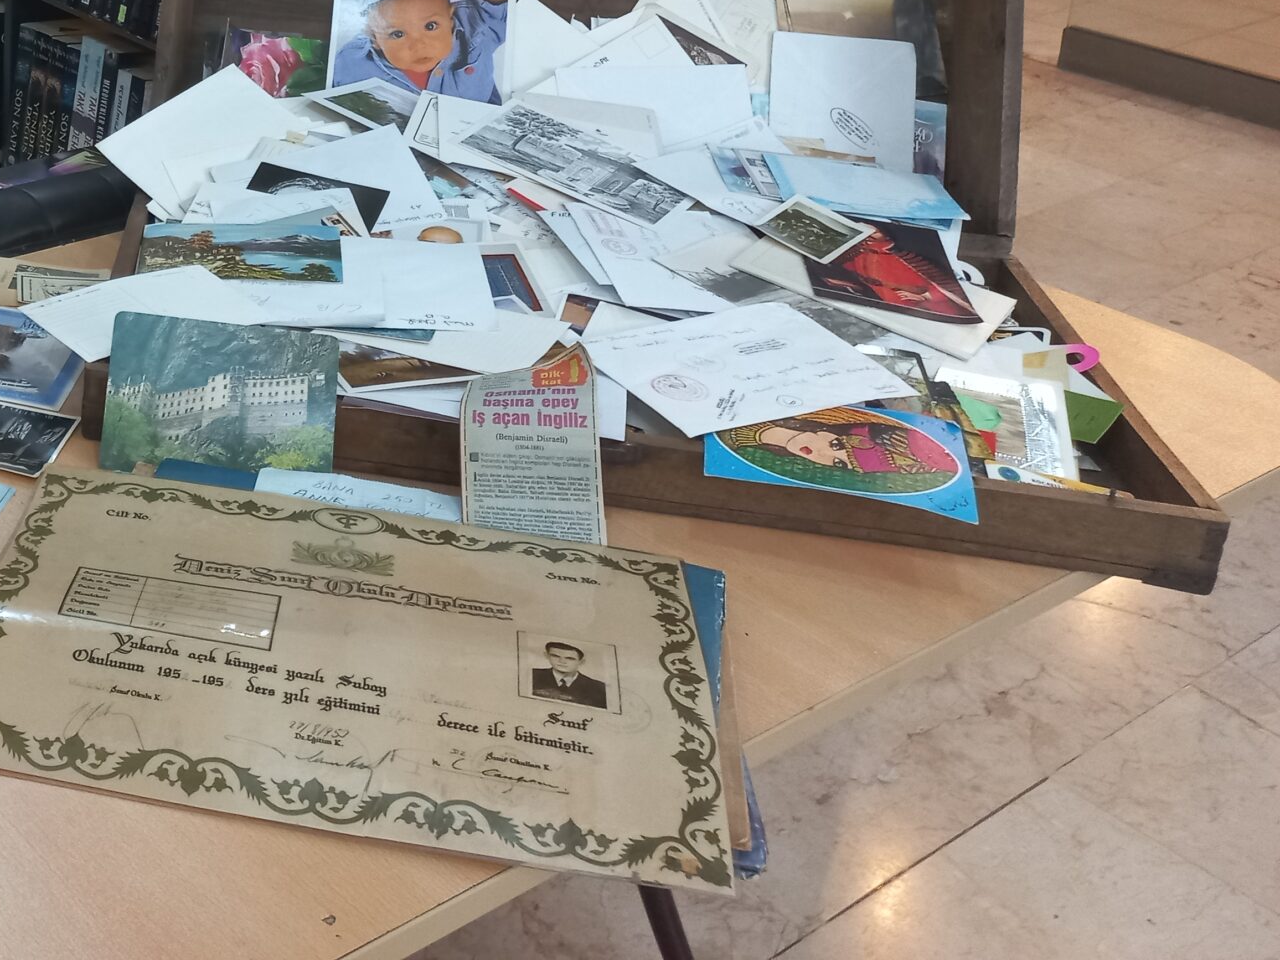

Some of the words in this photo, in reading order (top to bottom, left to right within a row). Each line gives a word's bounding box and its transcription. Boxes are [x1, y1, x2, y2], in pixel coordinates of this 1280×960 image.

[482, 397, 535, 410] başına
[541, 396, 580, 410] epey
[472, 410, 486, 428] iş
[492, 412, 531, 429] açan
[537, 409, 588, 430] İngiliz
[495, 432, 535, 443] (Benjamin
[536, 434, 569, 445] Disraeli)
[132, 511, 152, 522] No.
[173, 552, 242, 581] Deniz
[579, 574, 602, 587] No.
[110, 632, 180, 658] Yukarıda
[187, 646, 217, 666] açık
[223, 651, 279, 676] künyesi
[284, 667, 326, 684] yazılı
[335, 673, 388, 699] Subay
[72, 647, 146, 674] Okulunun
[245, 677, 276, 698] ders
[282, 685, 310, 706] yılı
[317, 695, 382, 717] eğitimini
[542, 711, 594, 732] Sınıf
[436, 711, 480, 735] derece
[487, 721, 507, 738] ile
[513, 725, 595, 756] bitirmiştir.
